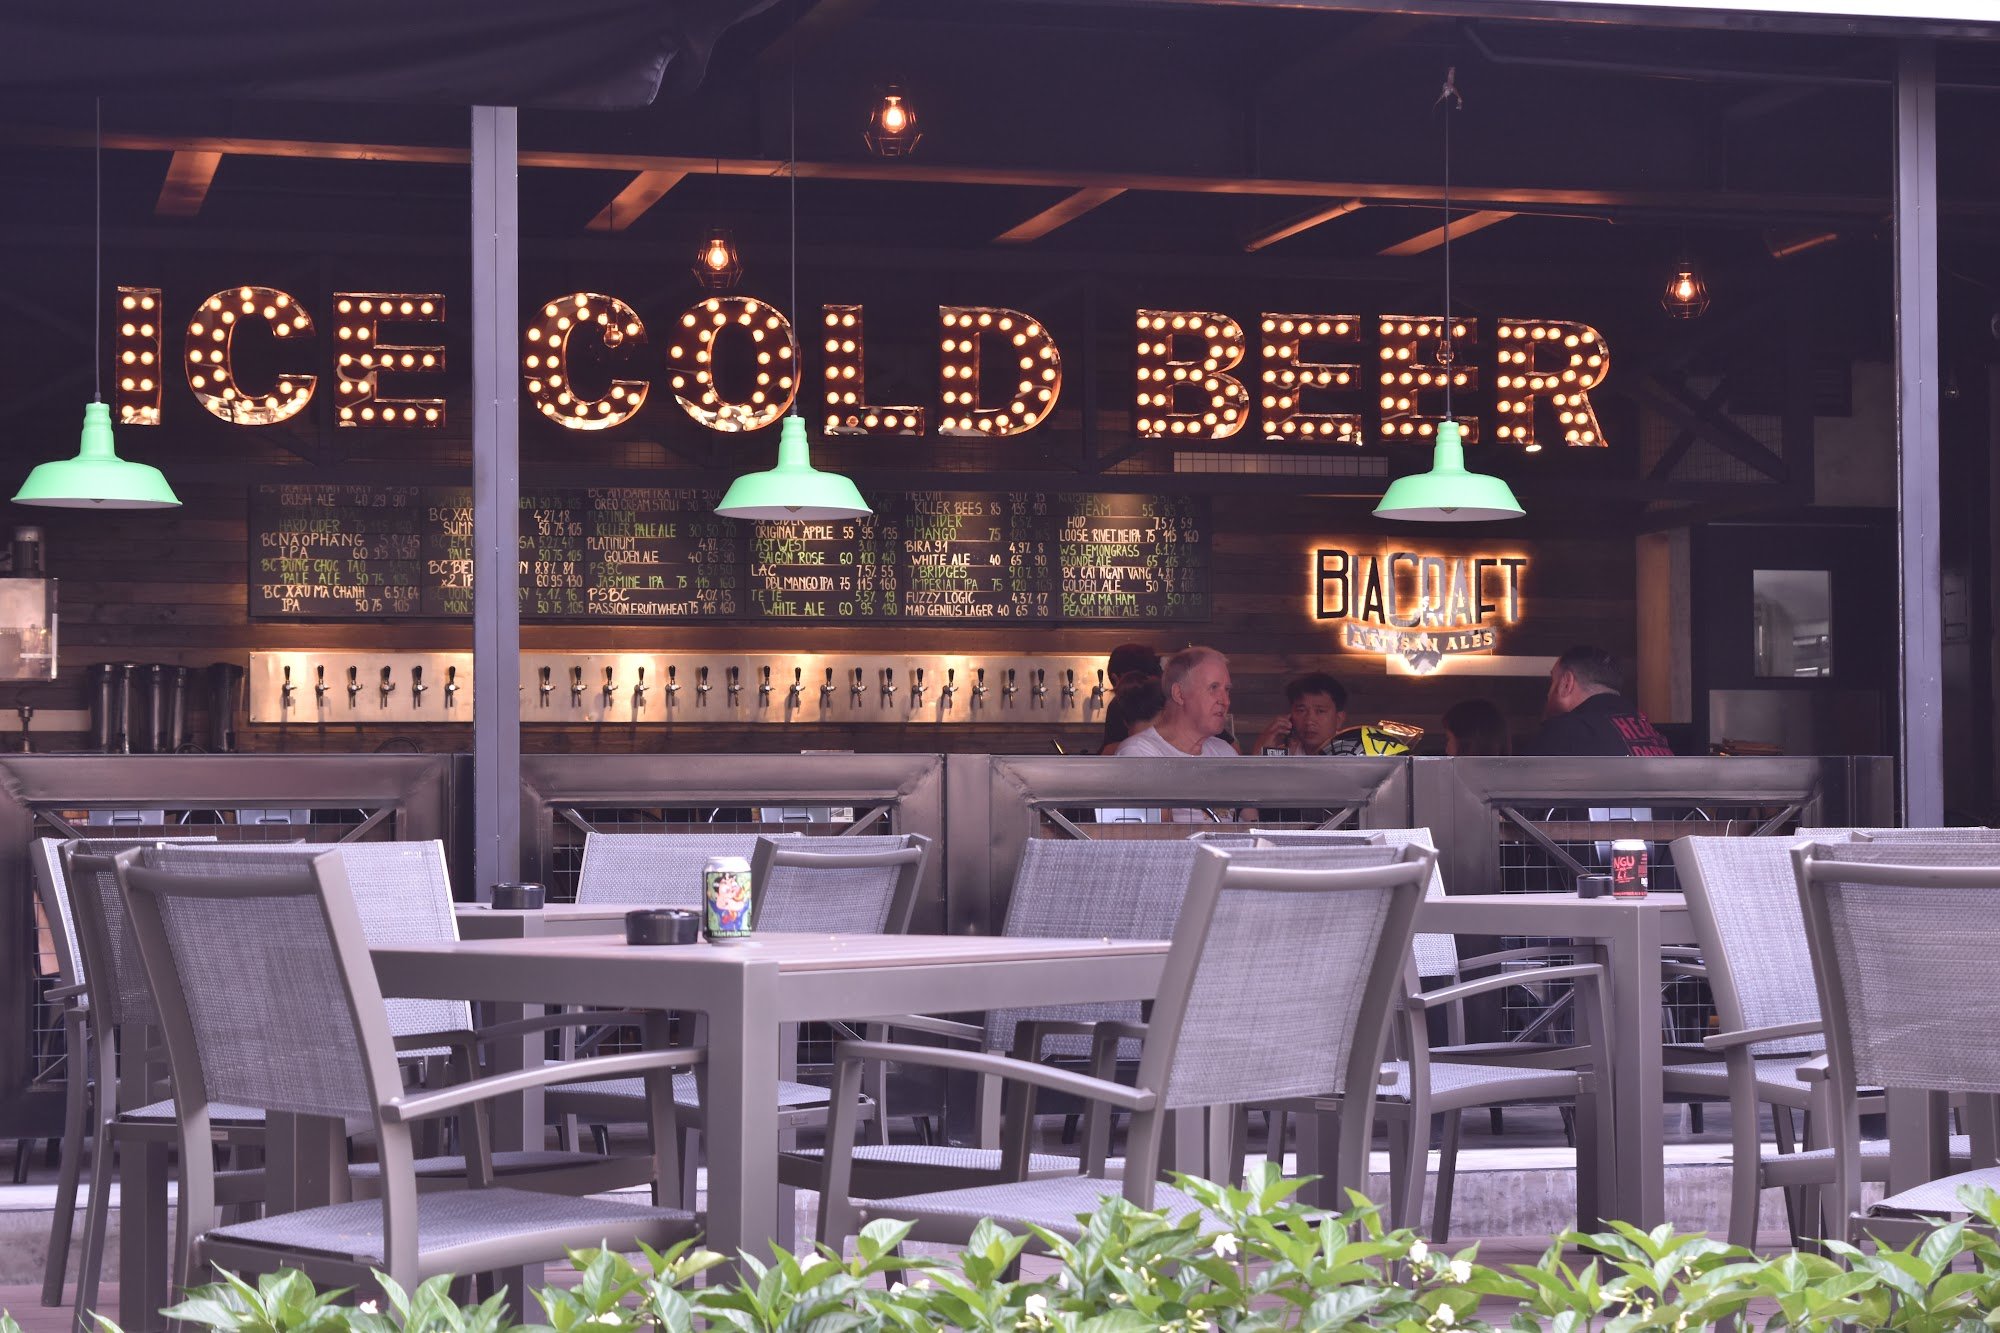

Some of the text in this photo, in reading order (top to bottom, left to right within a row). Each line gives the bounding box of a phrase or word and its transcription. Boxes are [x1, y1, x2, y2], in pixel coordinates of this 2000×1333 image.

[117, 286, 1610, 448] ICE COLD BEER
[428, 508, 448, 521] BC
[915, 502, 950, 514] KILLER
[954, 502, 983, 514] BEES
[990, 503, 1001, 515] 85
[1073, 504, 1154, 517] STEAM 55
[538, 523, 550, 536] 50
[553, 523, 564, 536] 75
[658, 523, 676, 537] ALE
[755, 526, 797, 538] ORIGINAL
[803, 526, 833, 539] APPLE
[843, 526, 854, 539] 55
[861, 527, 874, 539] 95
[914, 528, 1001, 541] MANGO 75
[1059, 529, 1088, 542] LOOSE
[1145, 529, 1155, 542] 75
[1184, 530, 1199, 542] 160
[587, 537, 635, 550] PLATINUM
[777, 539, 807, 551] WEST
[904, 540, 931, 553] BIRA
[934, 540, 948, 552] 91
[280, 545, 368, 560] IPA 60
[538, 550, 550, 562] 50
[604, 551, 640, 563] GOLDEN
[643, 551, 659, 563] ALE
[688, 551, 702, 563] 40
[1081, 544, 1140, 557] LEMONGRASS
[758, 552, 793, 564] SAIGON
[798, 552, 825, 564] ROSE
[840, 552, 853, 565] 60
[912, 553, 1047, 566] WHITE ALE 40 65 90
[1060, 555, 1158, 567] BLONDE ALE 65
[428, 561, 448, 574] BC
[751, 564, 776, 577] LAC
[881, 565, 893, 578] 55
[917, 566, 967, 578] BRIDGES
[1062, 567, 1075, 579] BC
[280, 572, 308, 585] PALE
[319, 572, 341, 585] ALE
[356, 573, 369, 585] 50
[536, 575, 548, 588] 60
[551, 575, 563, 588] 95
[597, 576, 641, 588] JASMINE
[648, 576, 664, 588] IPA
[676, 576, 688, 588] 75
[765, 577, 783, 589] DBL
[784, 577, 818, 589] MANGO
[840, 577, 851, 590] 75
[857, 578, 873, 590] 115
[879, 578, 897, 590] 160
[912, 579, 956, 591] IMPERIAL
[964, 579, 978, 591] IPA
[991, 579, 1003, 591] 75
[262, 585, 280, 599] BC
[1062, 580, 1096, 592] GOLDEN
[1101, 580, 1122, 592] ALE
[1146, 580, 1158, 592] 50
[1316, 548, 1527, 627] BIACRAFT
[587, 588, 630, 601] PSBC
[906, 592, 941, 604] FUZZY
[945, 592, 975, 604] LOGIC
[1036, 592, 1048, 604] 17
[1061, 593, 1076, 605] BC
[281, 599, 300, 612] IPA
[355, 599, 368, 612] 50
[371, 599, 383, 612] 75
[588, 602, 629, 614] PASSION
[720, 602, 736, 614] 160
[761, 602, 797, 615] WHITE
[804, 602, 825, 615] ALE
[839, 602, 853, 615] 60
[861, 602, 873, 615] 95
[905, 605, 1048, 616] MAD GENIUS LAGER 40 65 90
[1063, 605, 1093, 616] PEACH
[1122, 605, 1140, 616] ALE
[1351, 630, 1493, 653] ARTISAN ALES
